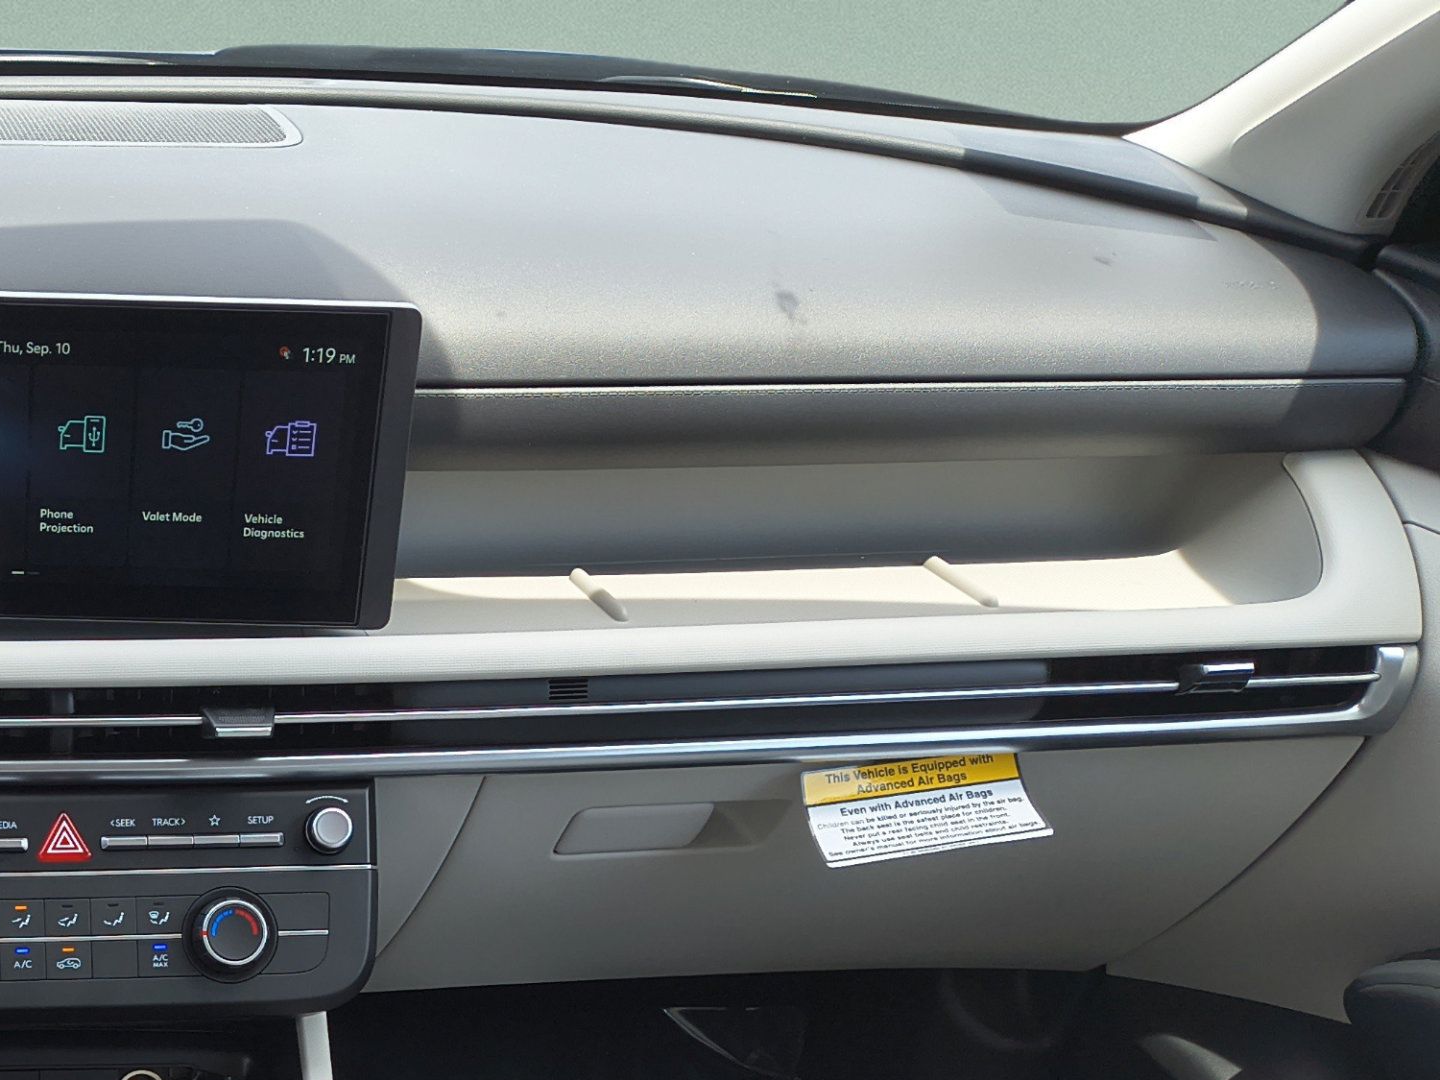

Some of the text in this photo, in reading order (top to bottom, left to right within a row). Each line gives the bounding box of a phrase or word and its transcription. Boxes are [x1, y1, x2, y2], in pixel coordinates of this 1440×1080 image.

[26, 342, 52, 357] Sep.
[56, 342, 71, 355] 10
[302, 347, 356, 363] 1:19 PM
[39, 508, 74, 520] Phone
[142, 511, 202, 523] Valet Mode
[244, 513, 283, 525] Vehicle
[39, 522, 94, 534] Projection
[243, 527, 305, 540] Diagnostics
[825, 754, 994, 784] This Vehicle is Equipped with
[857, 771, 967, 795] Advanced Air Bags
[839, 788, 994, 817] Even with Advanced Air Bags
[247, 815, 274, 825] SETUP
[152, 954, 168, 962] A/C
[14, 960, 32, 969] A/C
